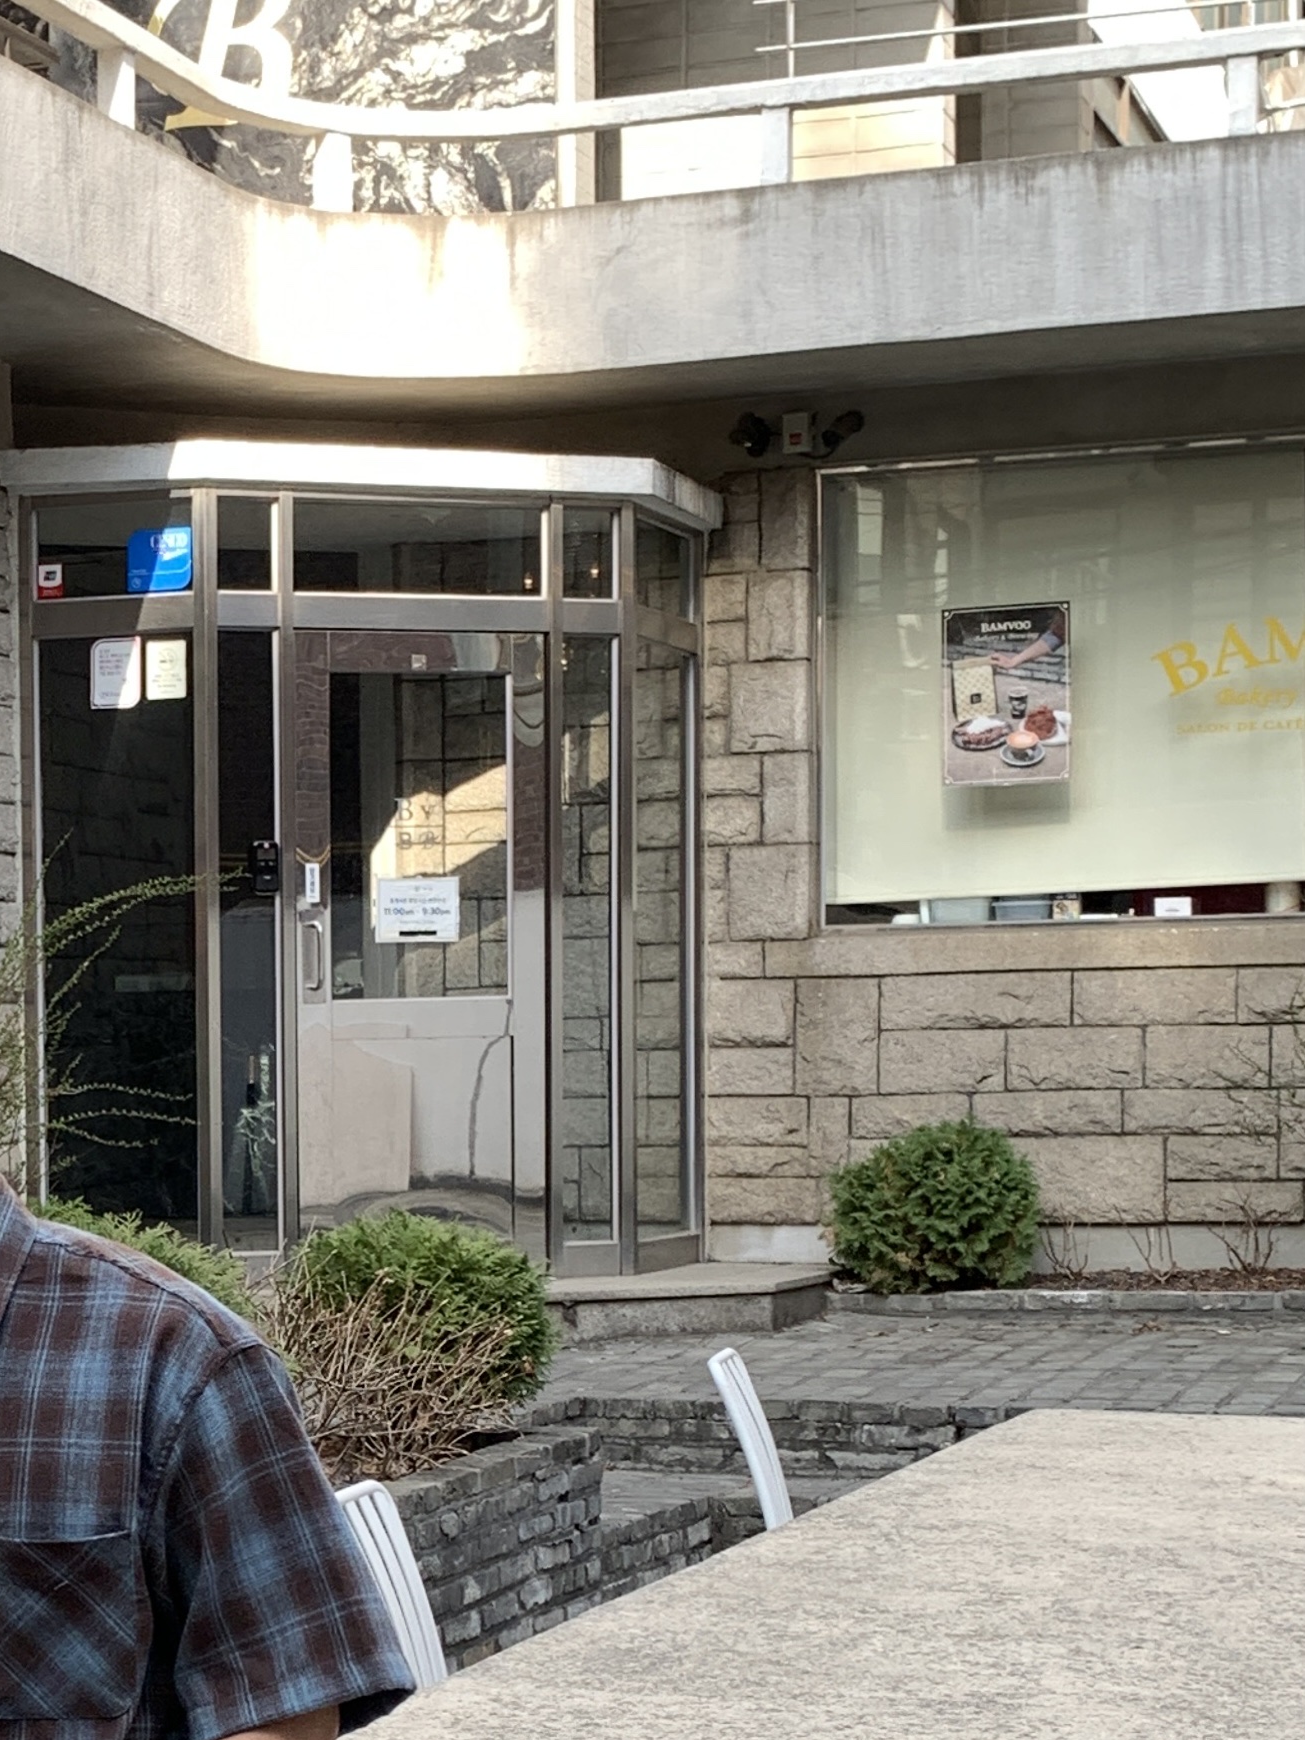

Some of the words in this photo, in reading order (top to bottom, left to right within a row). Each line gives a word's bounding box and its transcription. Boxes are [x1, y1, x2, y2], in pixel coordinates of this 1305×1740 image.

[981, 620, 1032, 633] BAMVOO
[1151, 616, 1305, 696] BAM
[1215, 686, 1297, 708] Bakery
[1176, 721, 1230, 734] SALON
[1237, 721, 1257, 732] DE
